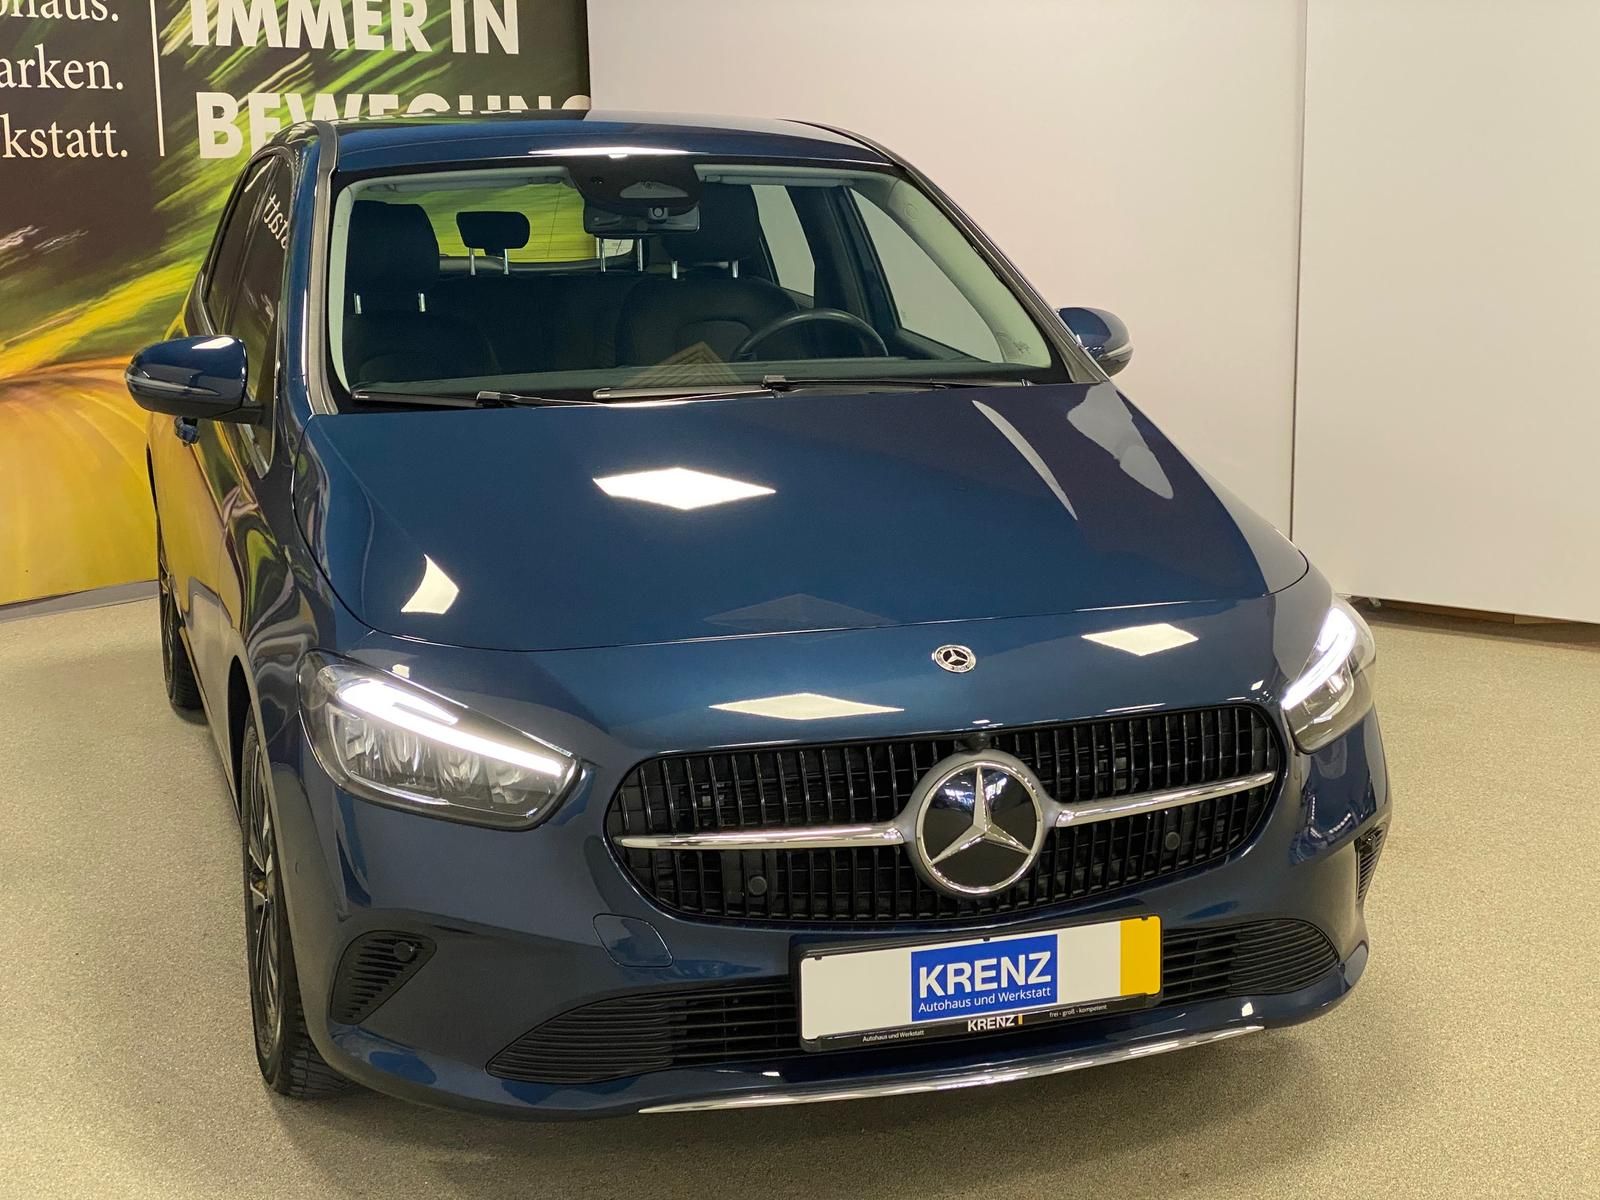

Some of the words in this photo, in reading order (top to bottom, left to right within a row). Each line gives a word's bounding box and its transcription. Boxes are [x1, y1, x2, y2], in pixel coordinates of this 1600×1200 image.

[190, 0, 433, 52] IMMER
[450, 0, 519, 55] IN
[0, 113, 128, 158] kstatt.
[919, 951, 1052, 999] KRENZ
[918, 999, 971, 1013] Autohaus
[974, 993, 995, 1006] und
[998, 987, 1051, 1000] Werkstatt
[862, 1034, 887, 1043] Autohaus
[900, 1030, 925, 1038] Werkstatt
[967, 1015, 1015, 1032] KRENZ
